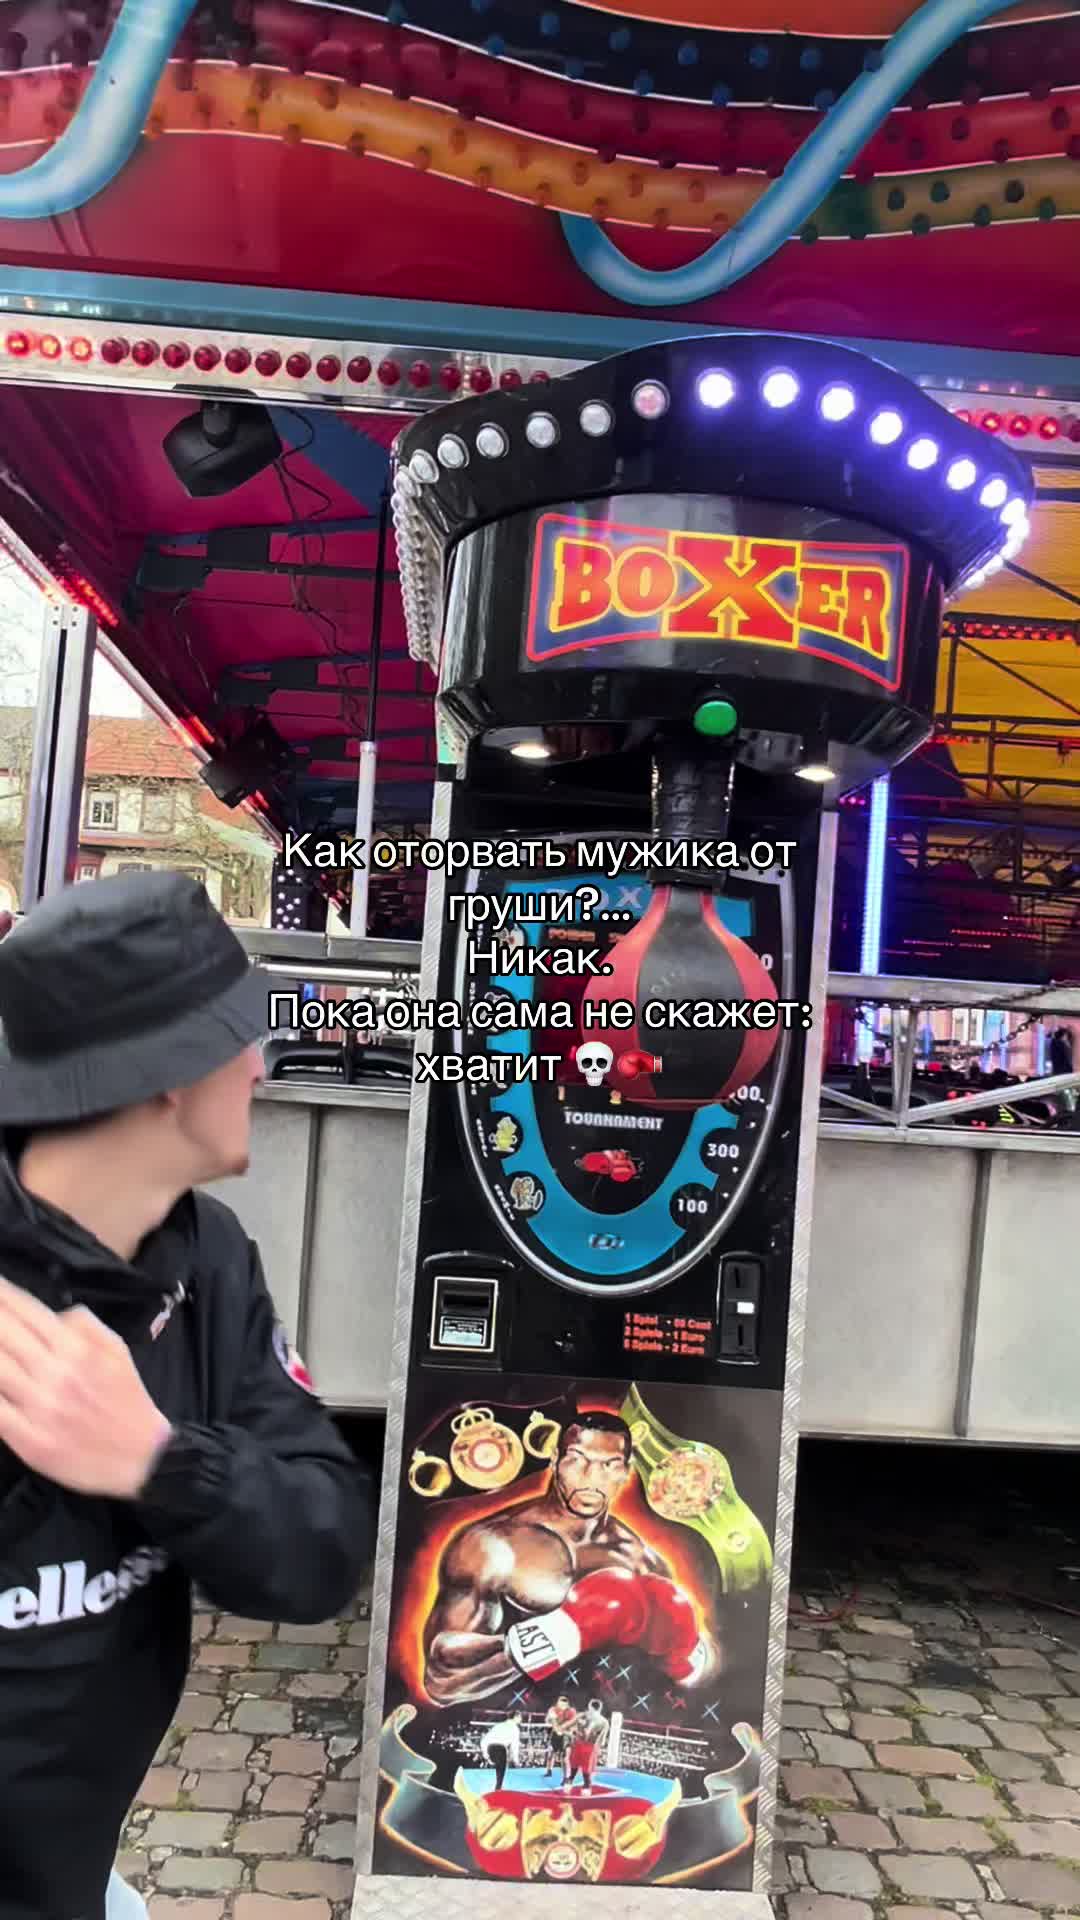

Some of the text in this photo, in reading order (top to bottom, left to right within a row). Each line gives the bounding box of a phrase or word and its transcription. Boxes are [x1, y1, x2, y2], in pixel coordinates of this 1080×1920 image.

[549, 530, 893, 661] BOXER
[729, 1084, 761, 1102] 00
[563, 1110, 664, 1132] TOURNAMENT
[706, 1143, 740, 1159] 300
[677, 1198, 708, 1214] 100
